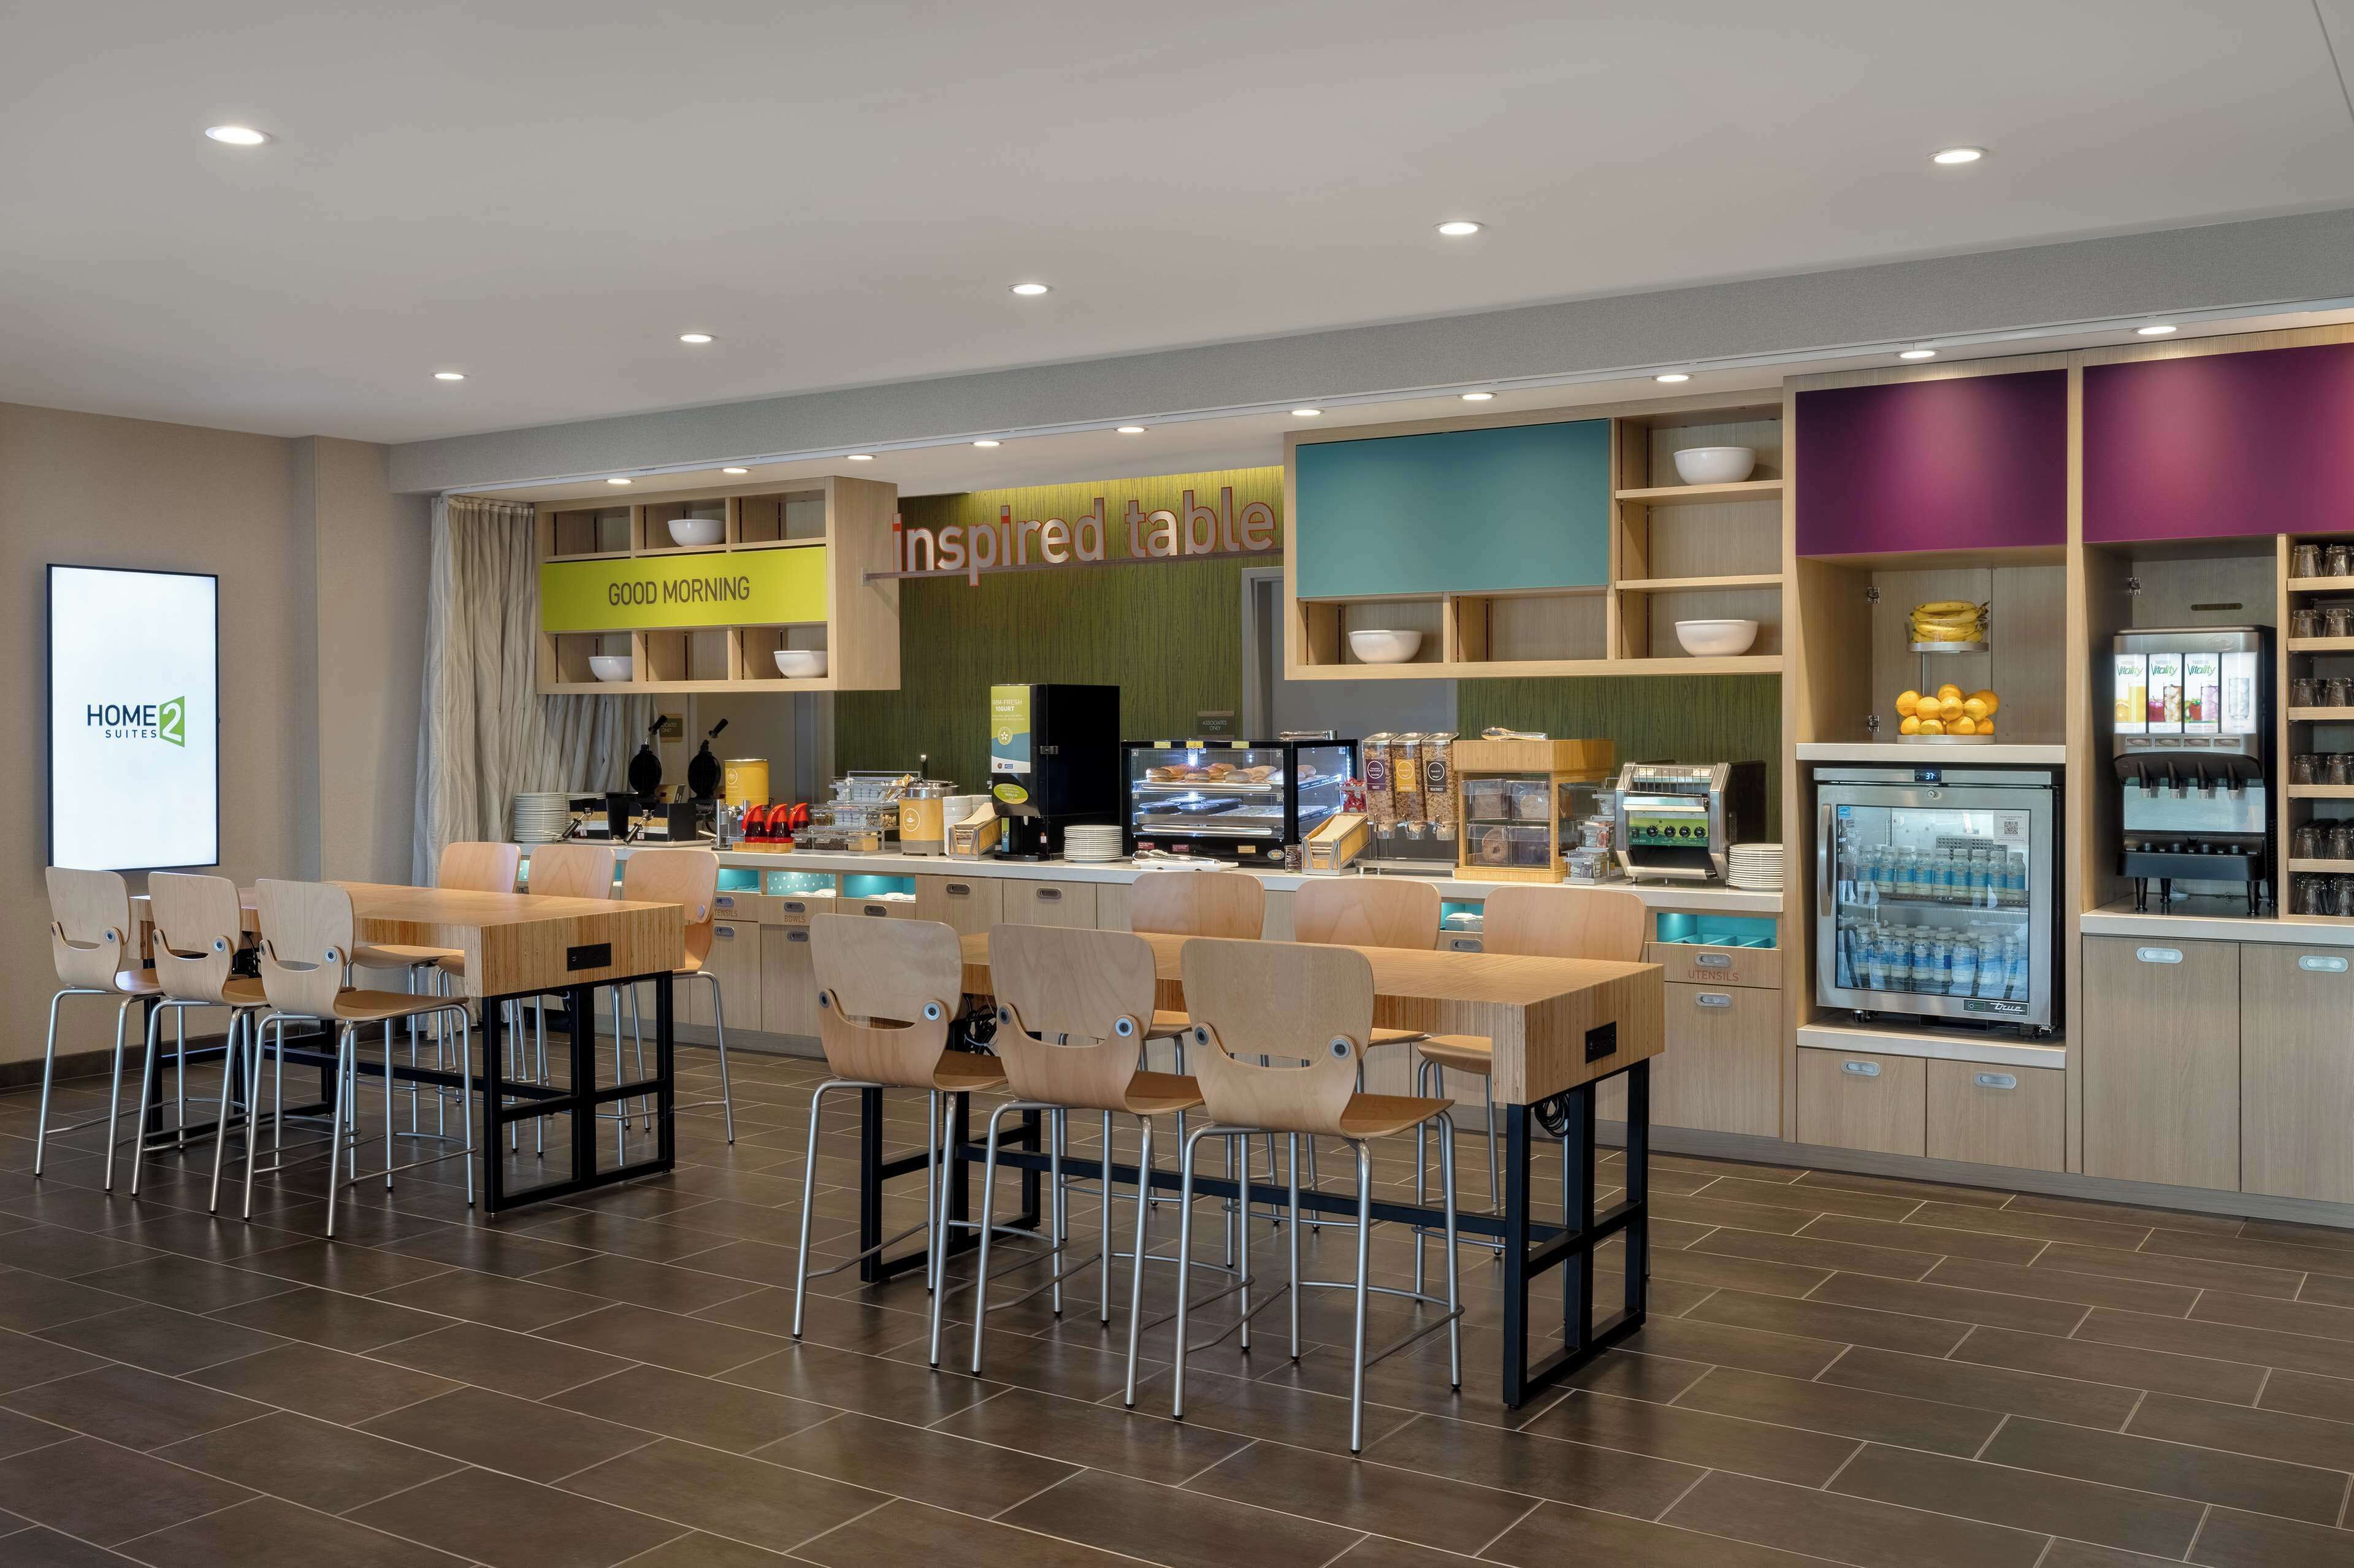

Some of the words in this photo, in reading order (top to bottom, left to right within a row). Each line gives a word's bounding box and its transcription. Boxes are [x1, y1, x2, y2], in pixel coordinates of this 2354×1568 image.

[892, 497, 1104, 586] inspired
[1124, 486, 1276, 558] table
[609, 581, 657, 606] GOOD
[663, 576, 751, 604] MORNING
[2117, 663, 2144, 676] Vitality
[2150, 663, 2178, 676] Vitality
[2187, 663, 2216, 676] Vitality
[87, 704, 157, 727] HOME
[162, 702, 183, 743] 2
[105, 729, 157, 738] SUITES
[1688, 969, 1739, 981] UTENSILS
[1990, 1002, 2023, 1012] true
